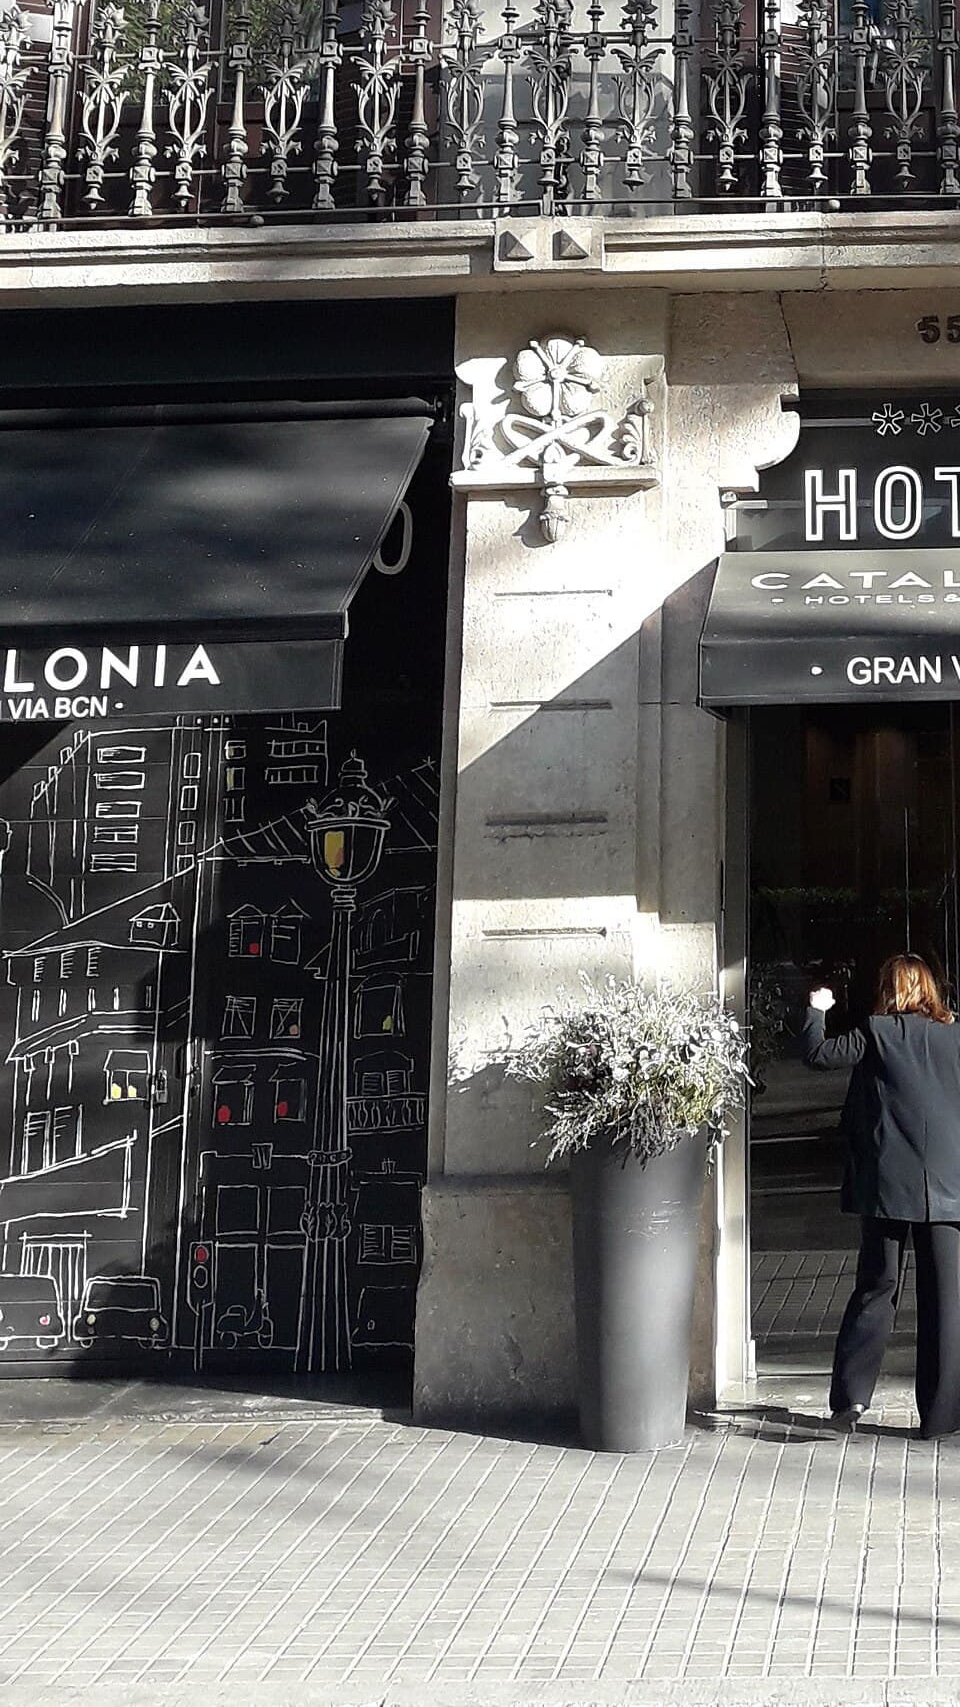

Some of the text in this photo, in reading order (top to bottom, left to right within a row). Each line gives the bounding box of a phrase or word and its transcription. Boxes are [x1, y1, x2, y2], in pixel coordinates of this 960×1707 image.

[805, 594, 935, 605] HOTELS
[944, 593, 960, 603] &
[4, 644, 221, 693] LONIA
[846, 656, 942, 685] GRAN
[8, 697, 49, 719] VIA
[55, 695, 107, 719] BCN
